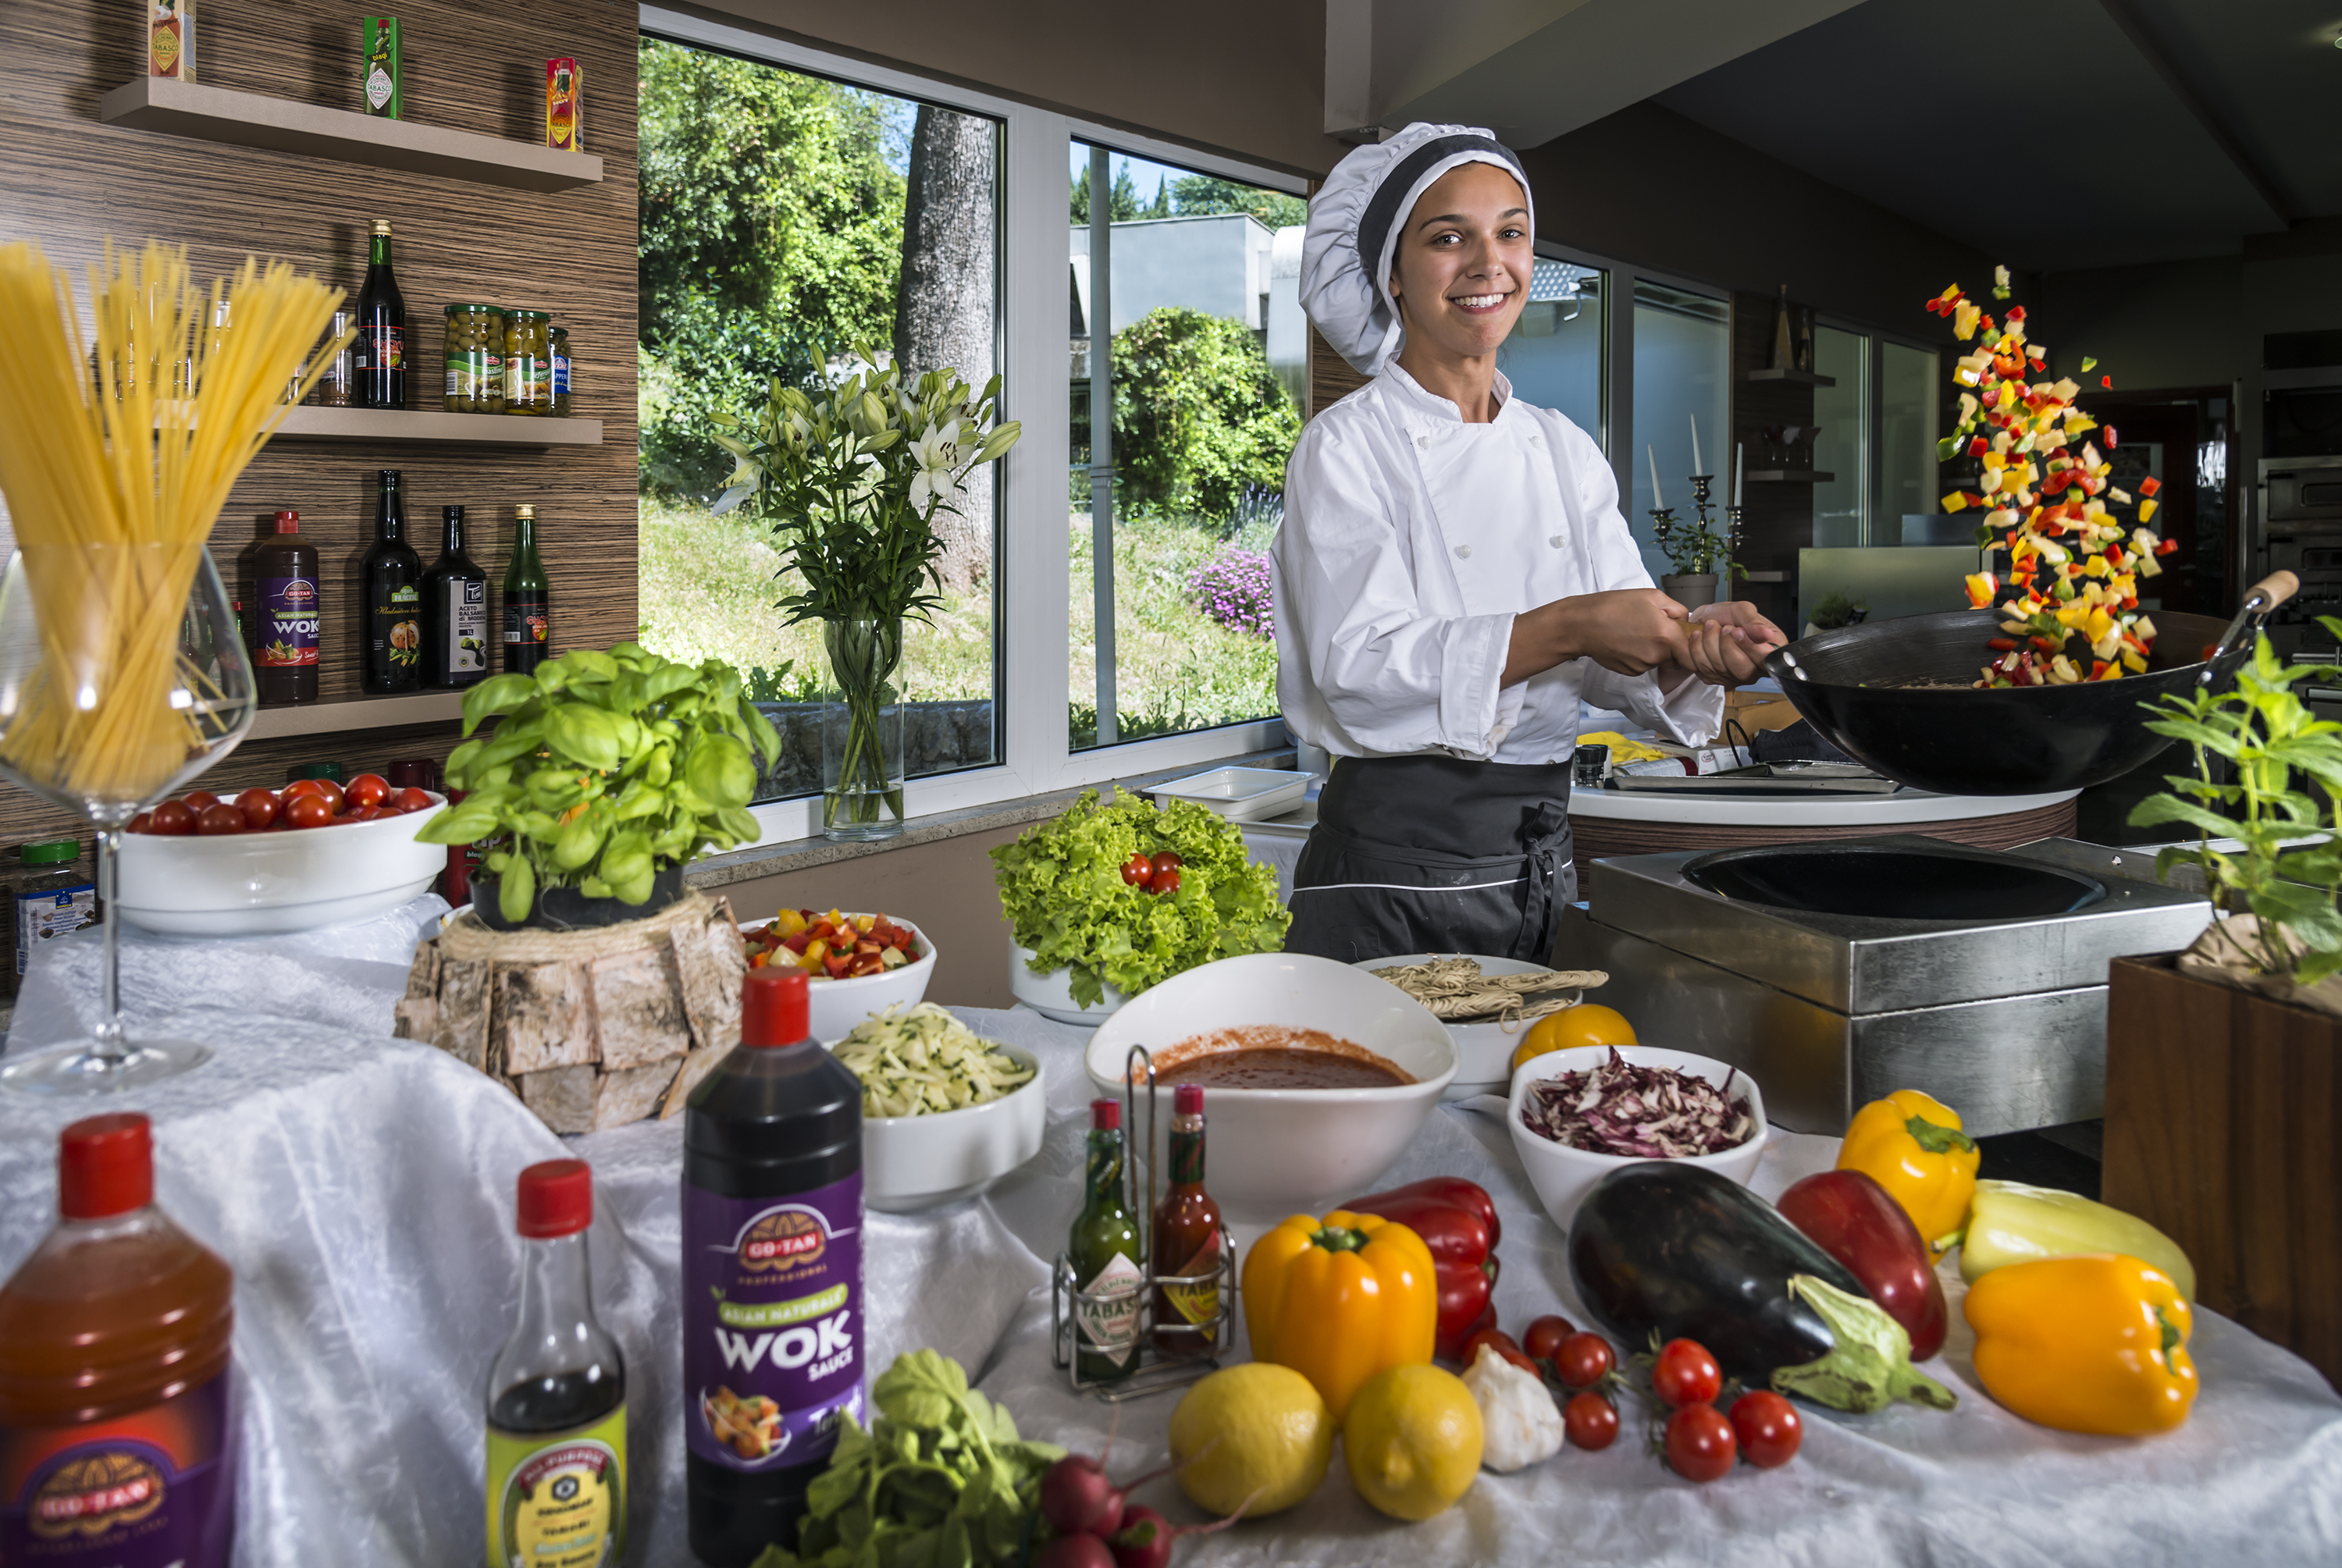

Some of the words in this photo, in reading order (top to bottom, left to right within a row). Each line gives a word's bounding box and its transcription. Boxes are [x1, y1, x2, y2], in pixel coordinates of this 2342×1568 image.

[152, 43, 178, 52] TABASCO
[368, 84, 392, 92] TABASCO
[553, 98, 569, 106] HOT
[724, 1308, 767, 1323] ASIAN
[771, 1289, 842, 1321] NATURALS
[714, 1310, 852, 1374] WOK
[807, 1346, 853, 1382] SAUCE
